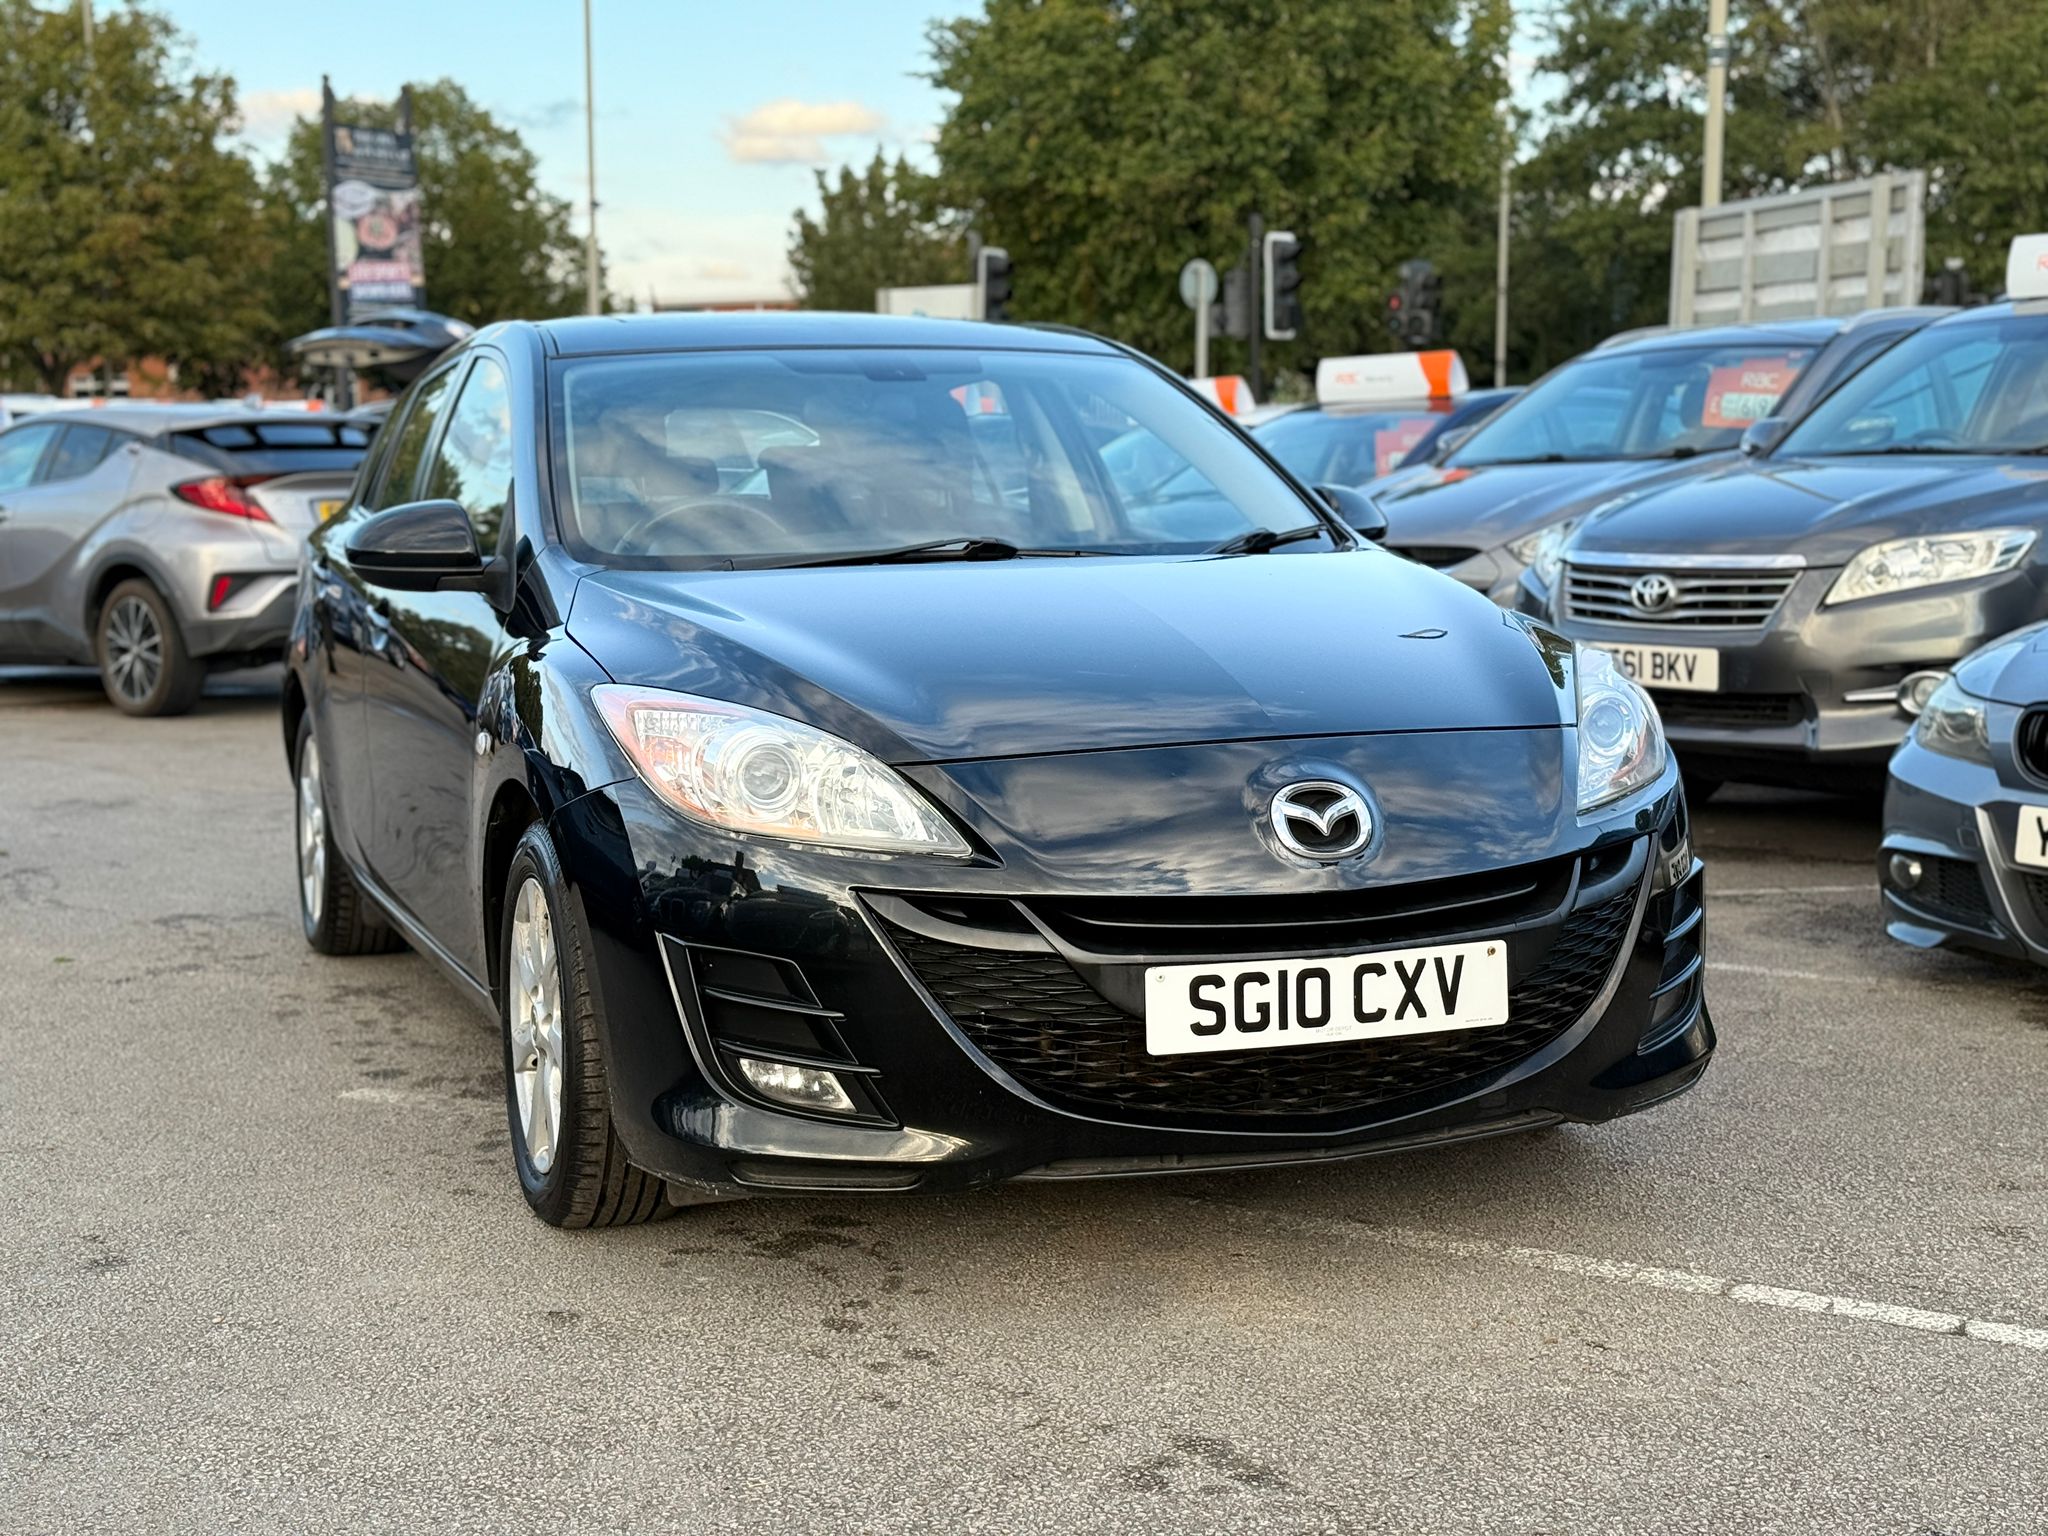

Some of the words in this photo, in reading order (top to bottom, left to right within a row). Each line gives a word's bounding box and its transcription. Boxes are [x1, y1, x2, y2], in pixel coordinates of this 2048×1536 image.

[1651, 651, 1698, 683] BKV
[1189, 967, 1331, 1036] SG10
[1353, 954, 1465, 1024] CXV
